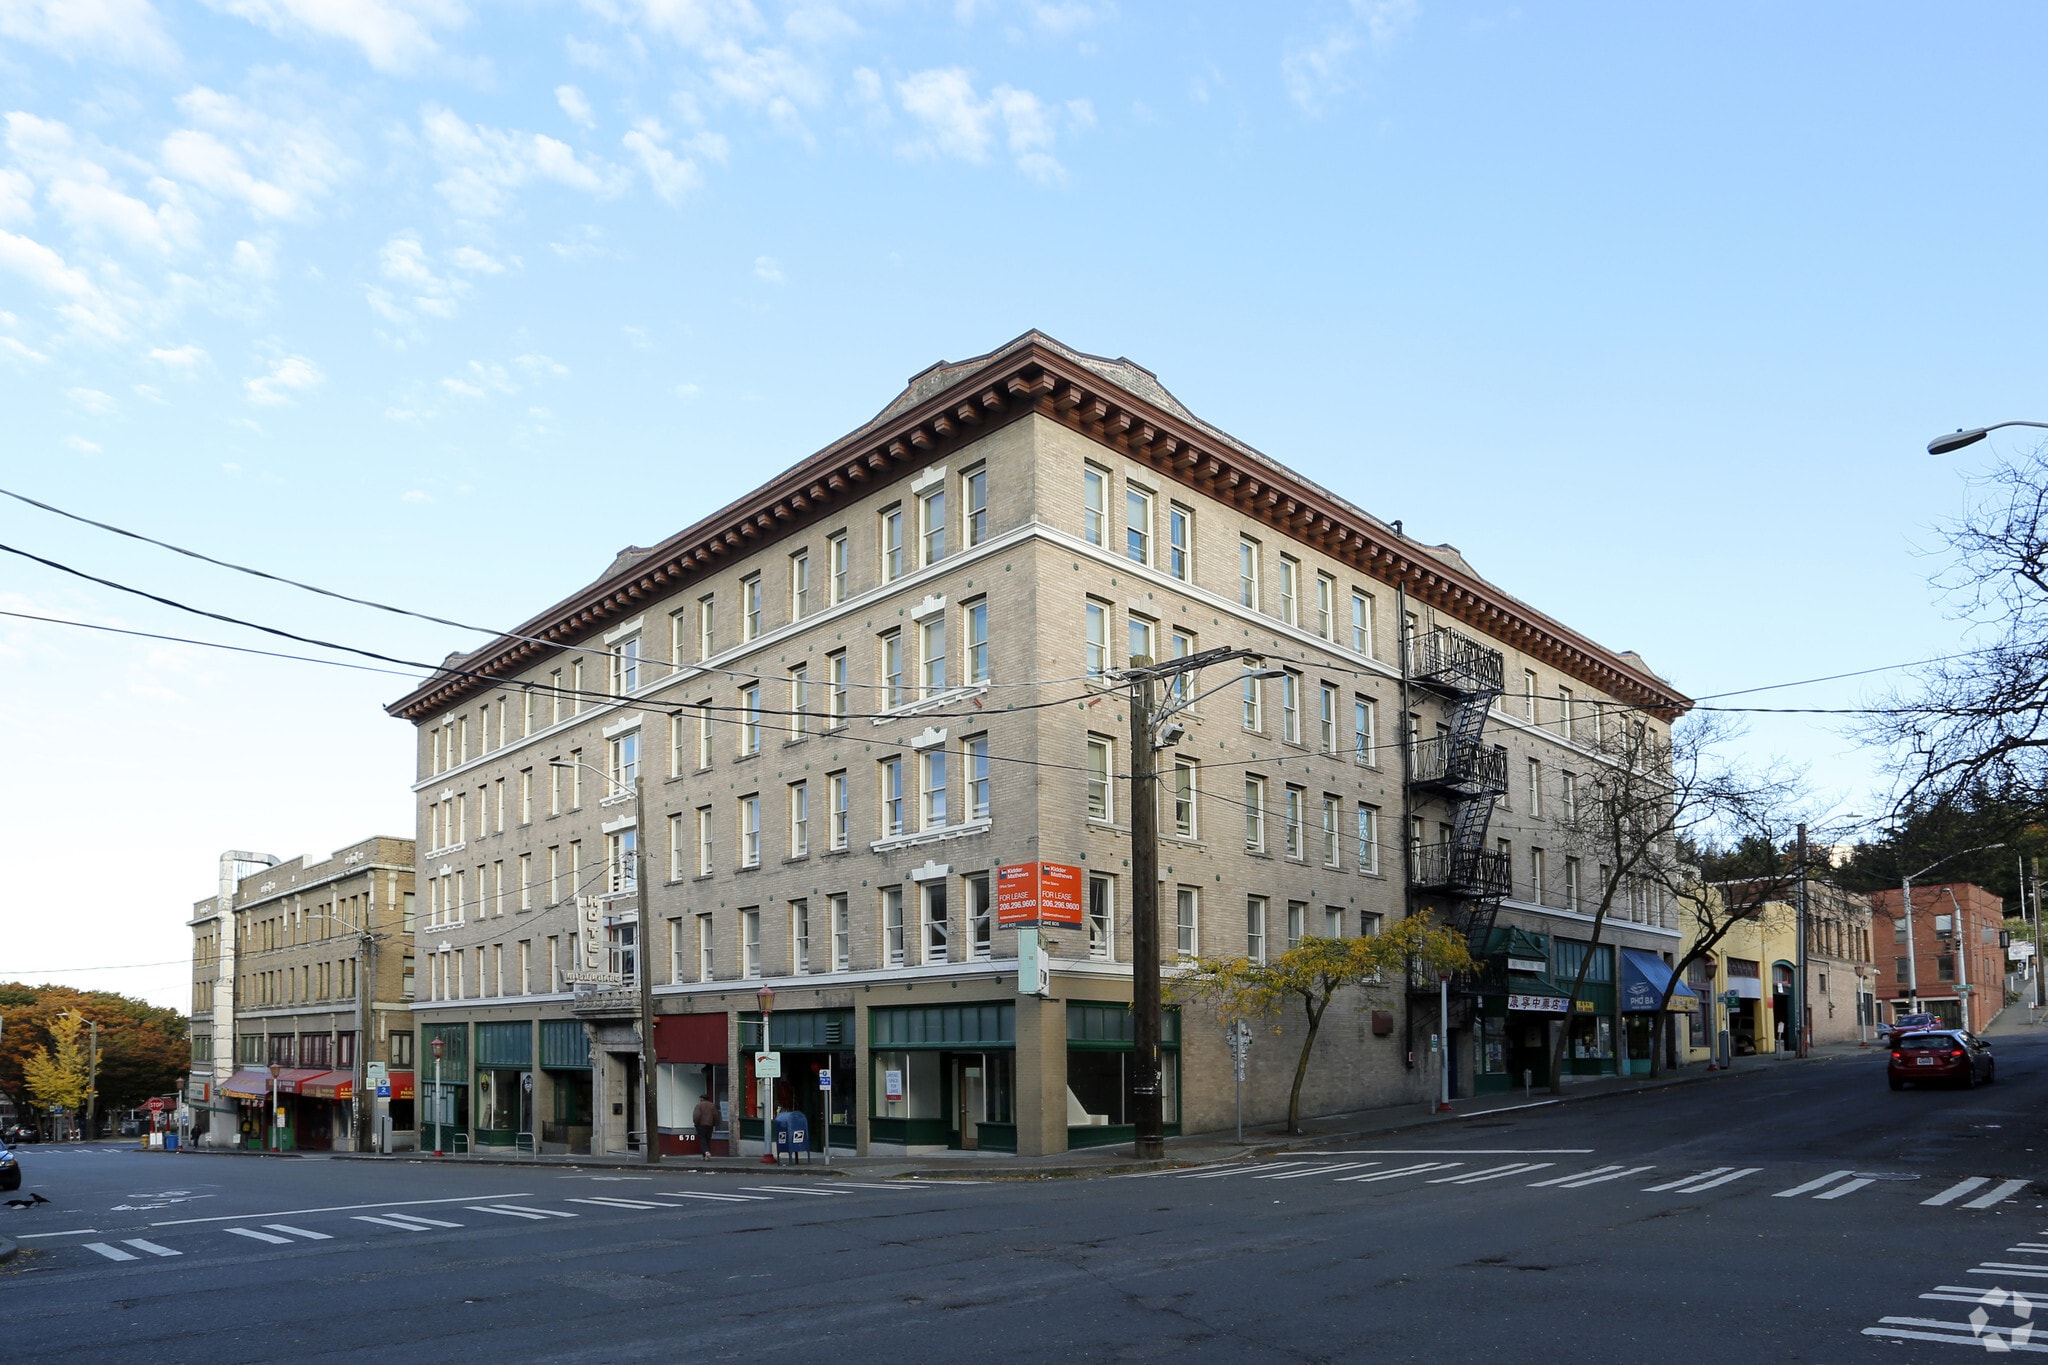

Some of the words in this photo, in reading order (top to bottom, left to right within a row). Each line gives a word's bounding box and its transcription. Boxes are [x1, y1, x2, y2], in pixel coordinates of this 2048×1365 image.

[1011, 892, 1029, 900] LEASE
[1054, 892, 1072, 900] LEASE
[586, 895, 599, 969] HOTEL
[1644, 996, 1654, 1004] BA
